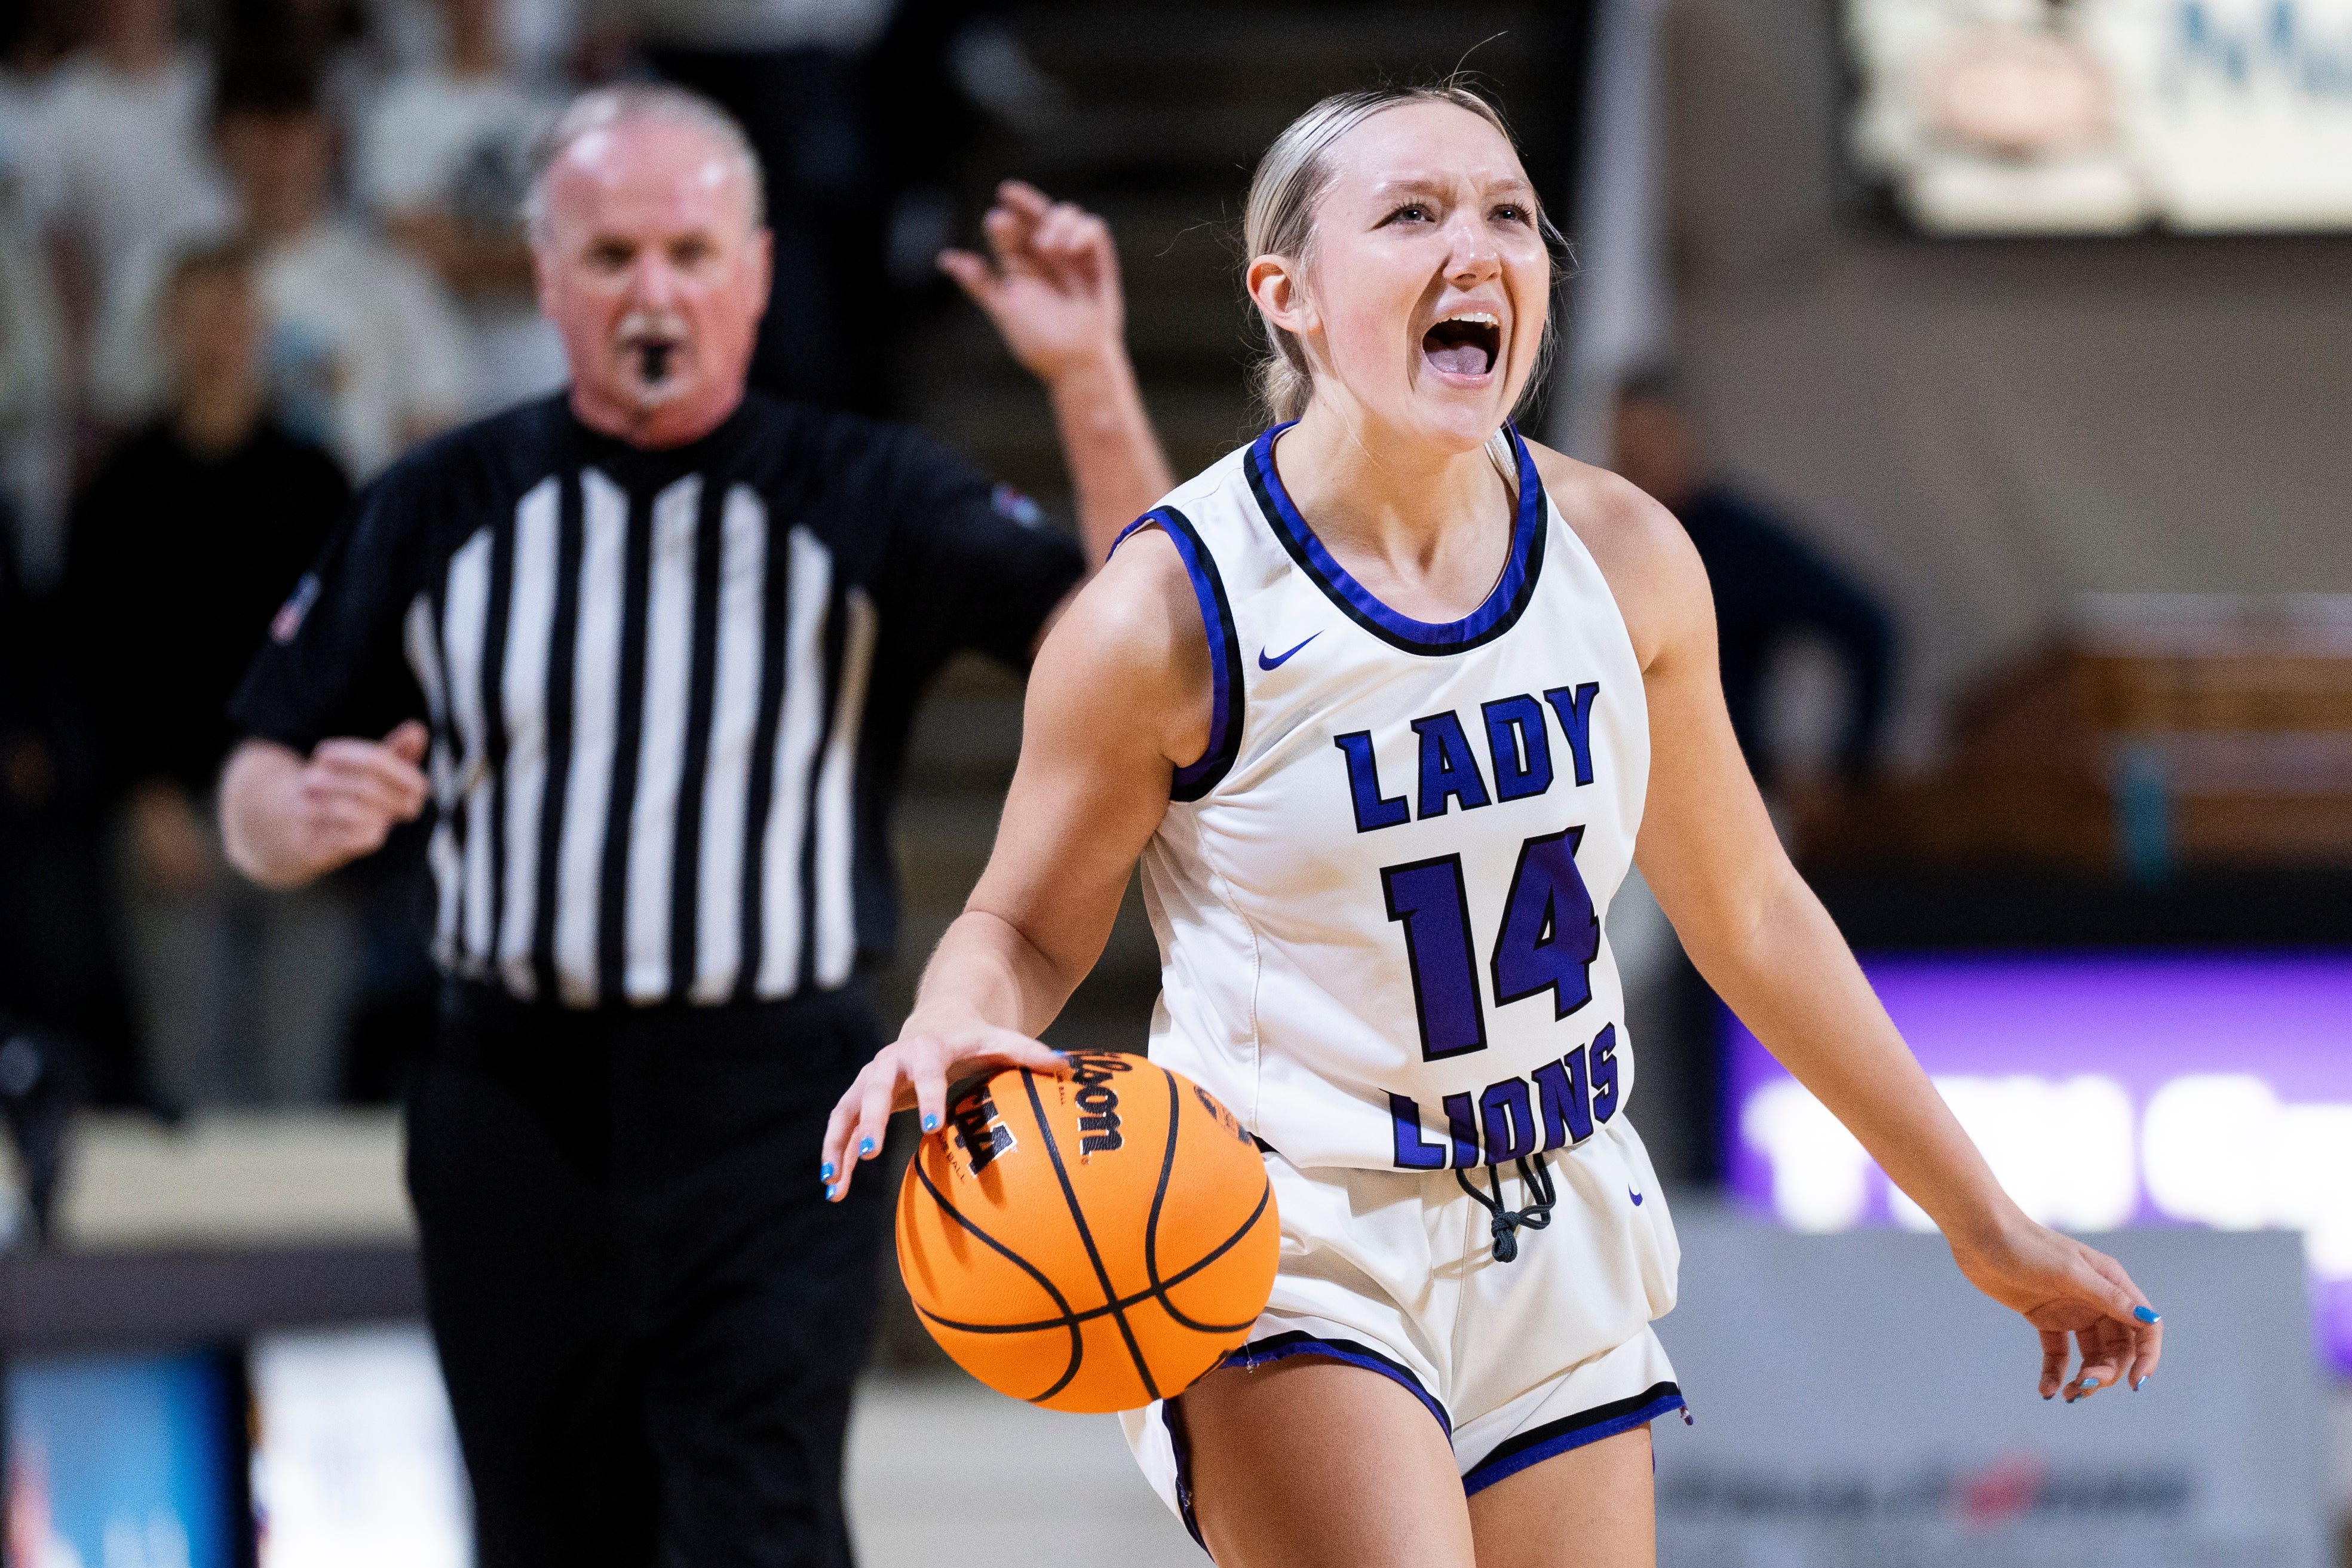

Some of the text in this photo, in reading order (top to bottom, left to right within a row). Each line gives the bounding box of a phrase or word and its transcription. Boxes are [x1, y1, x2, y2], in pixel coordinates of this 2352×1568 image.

[1334, 681, 1599, 834] LADY
[1379, 824, 1601, 1063] 14
[1380, 1021, 1618, 1170] LIONS
